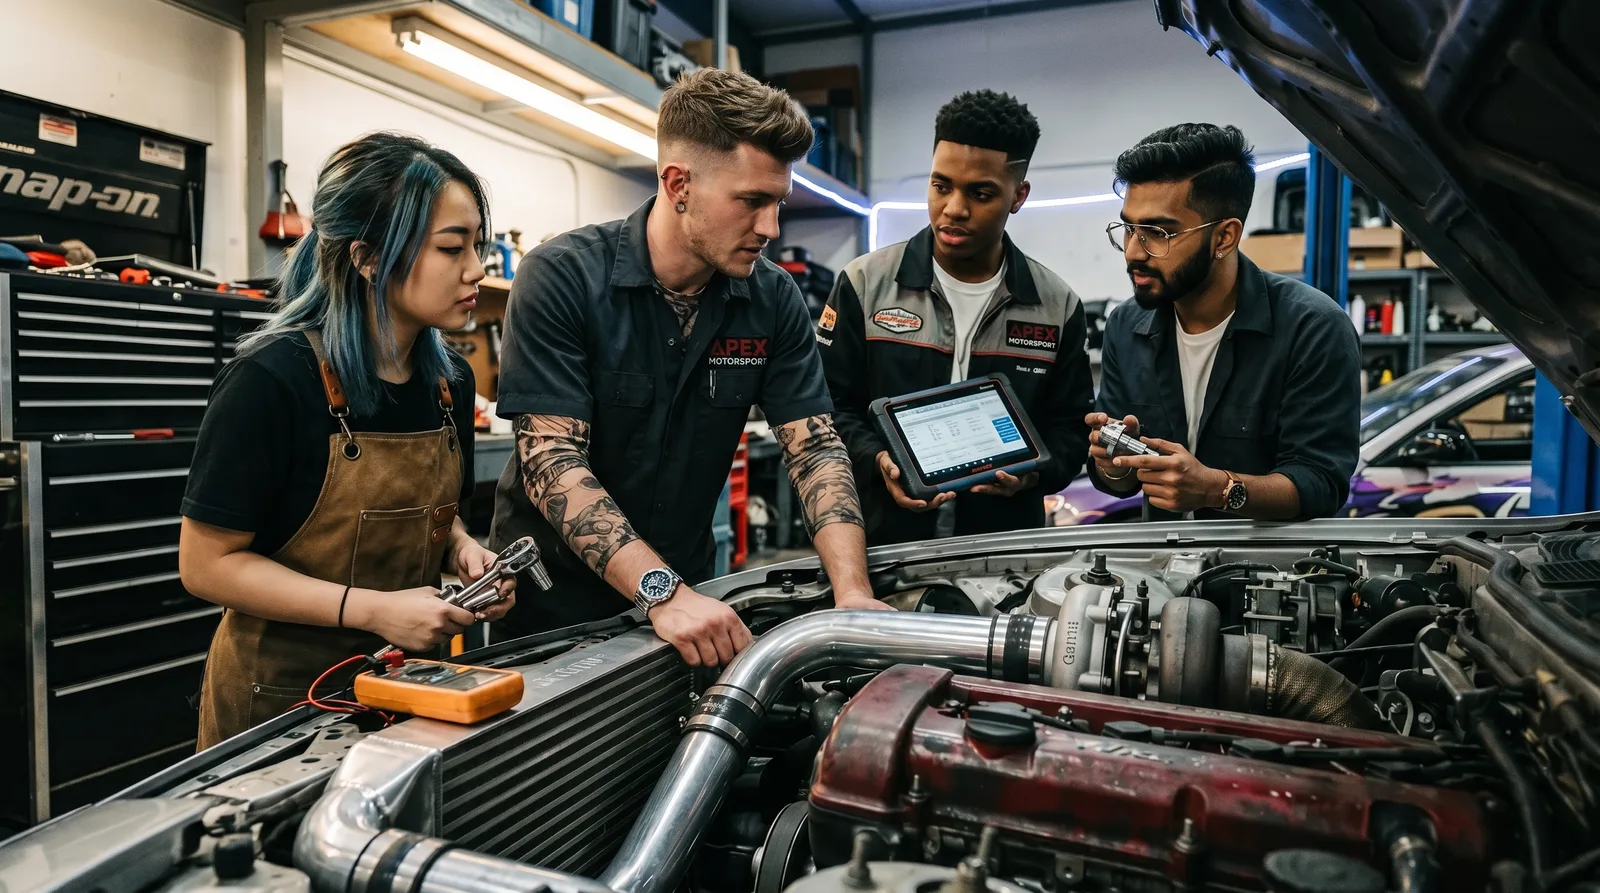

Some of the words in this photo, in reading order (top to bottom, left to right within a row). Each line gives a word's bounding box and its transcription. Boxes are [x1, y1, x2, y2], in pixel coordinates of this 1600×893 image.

[1009, 323, 1057, 342] APEX
[711, 338, 768, 356] APEX
[1008, 337, 1056, 349] MOTORSPORT
[708, 357, 768, 366] MOTORSPORT
